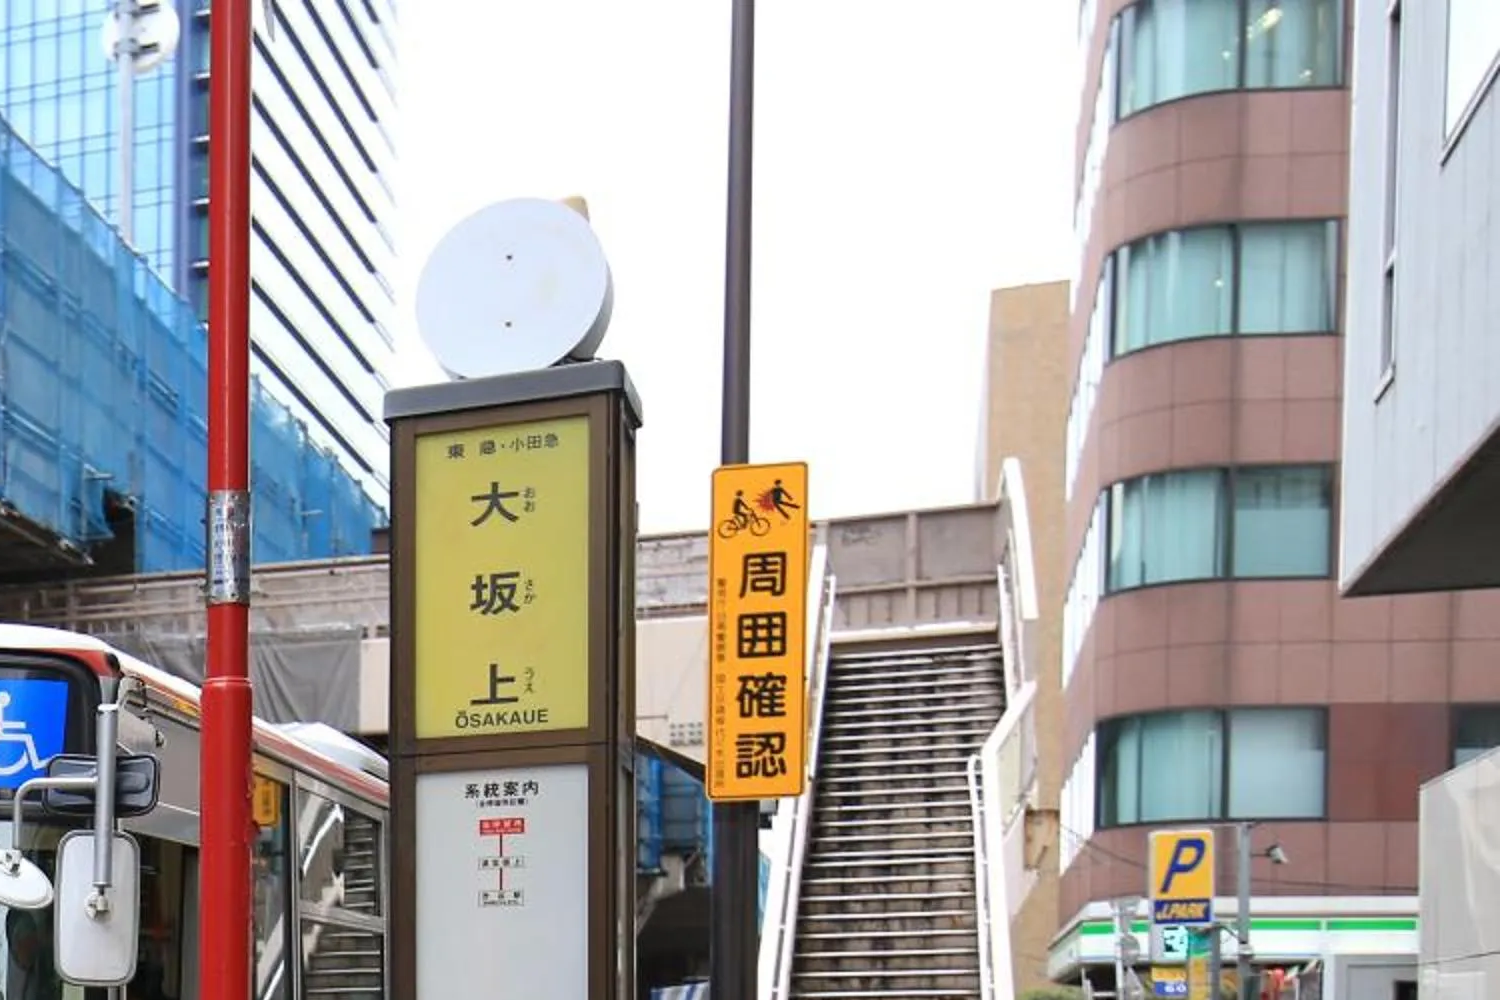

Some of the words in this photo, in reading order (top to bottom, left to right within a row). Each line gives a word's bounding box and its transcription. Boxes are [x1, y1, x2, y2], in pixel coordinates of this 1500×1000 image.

[470, 481, 520, 705] 大坂上
[735, 552, 787, 778] 周囲確認
[465, 781, 539, 799] 系統案内
[1160, 838, 1206, 894] P
